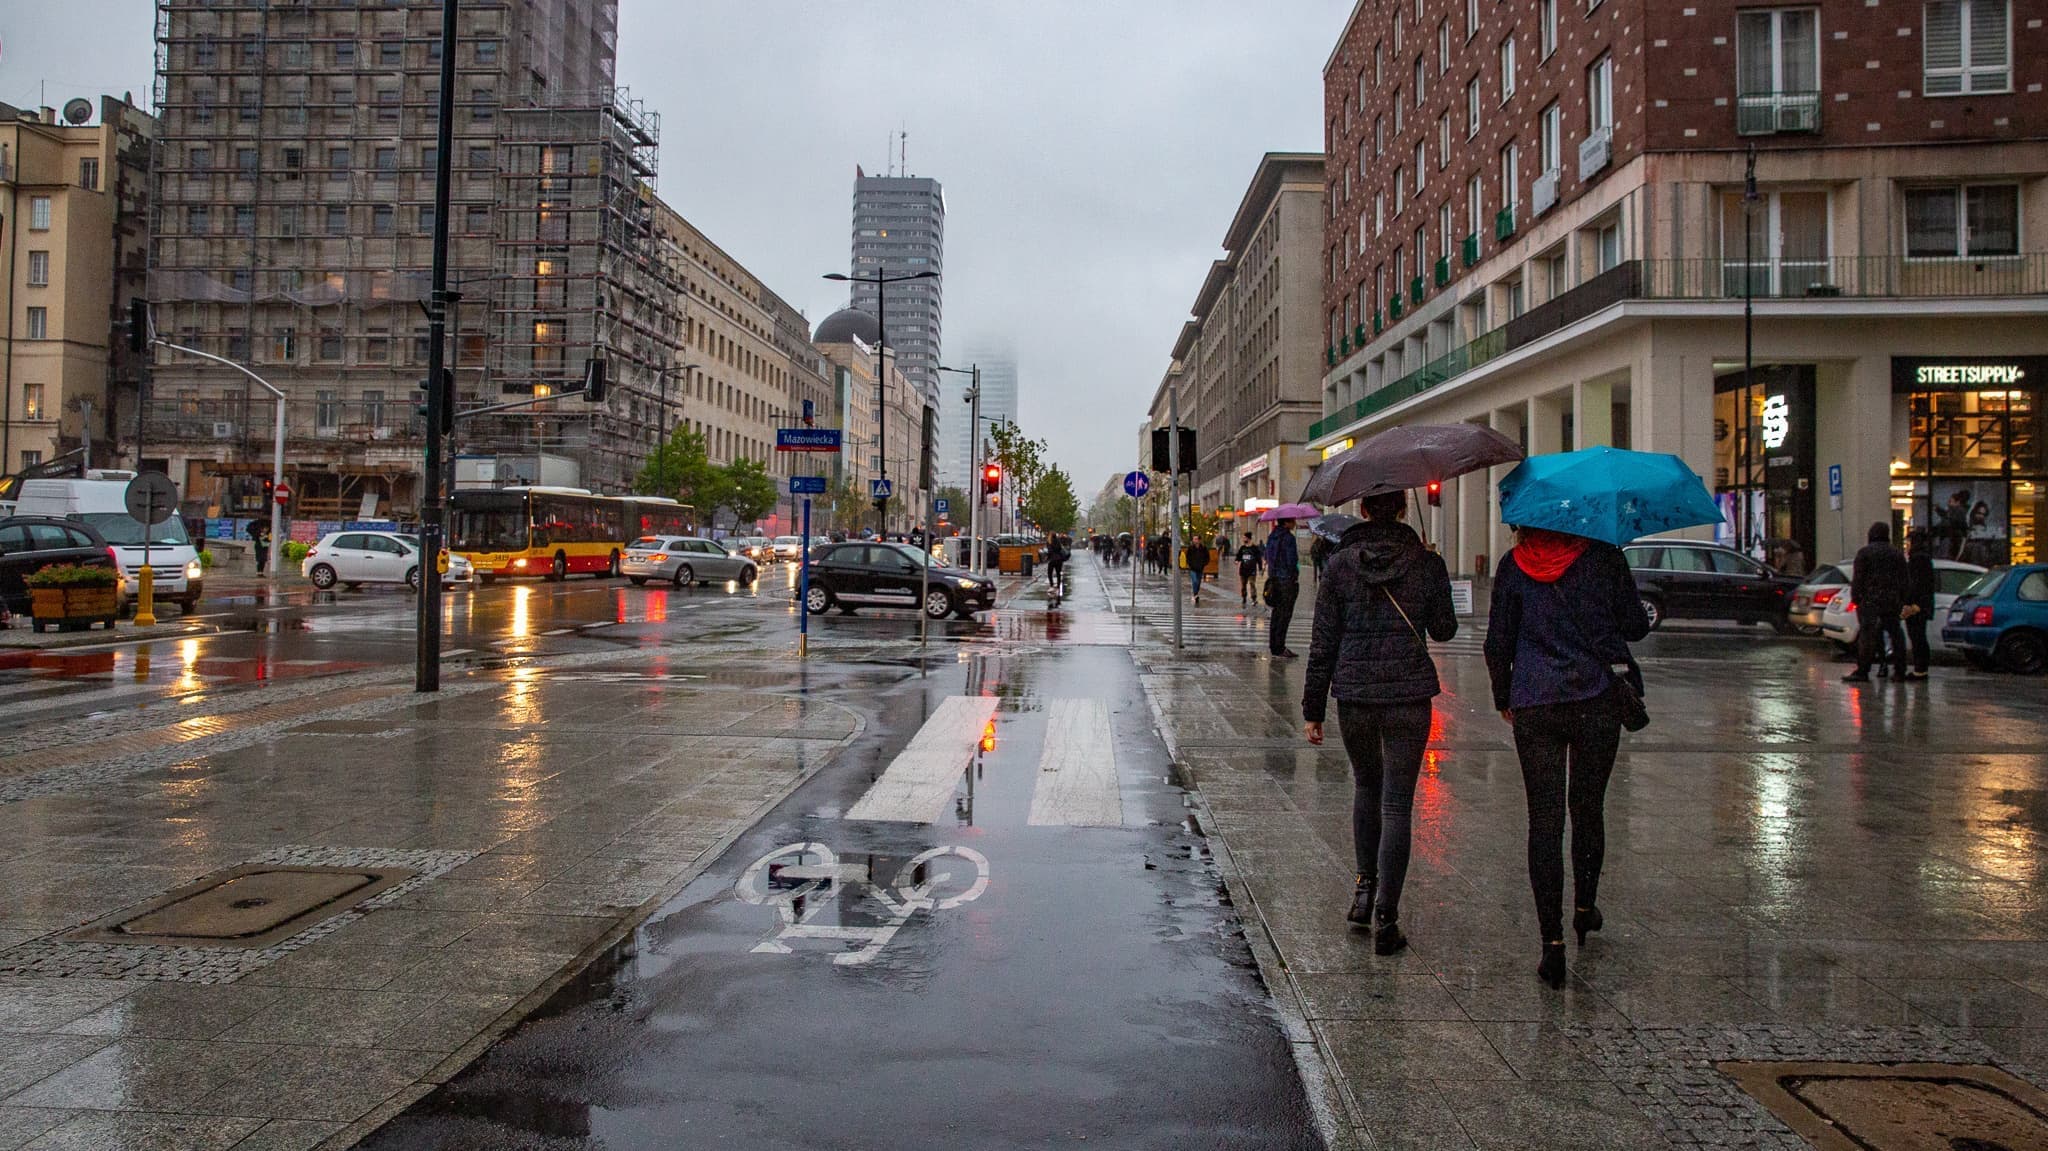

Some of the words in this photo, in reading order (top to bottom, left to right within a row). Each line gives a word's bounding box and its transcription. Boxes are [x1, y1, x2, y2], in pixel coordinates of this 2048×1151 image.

[783, 434, 834, 444] Mazowiecka
[793, 480, 801, 489] P
[937, 500, 946, 511] P
